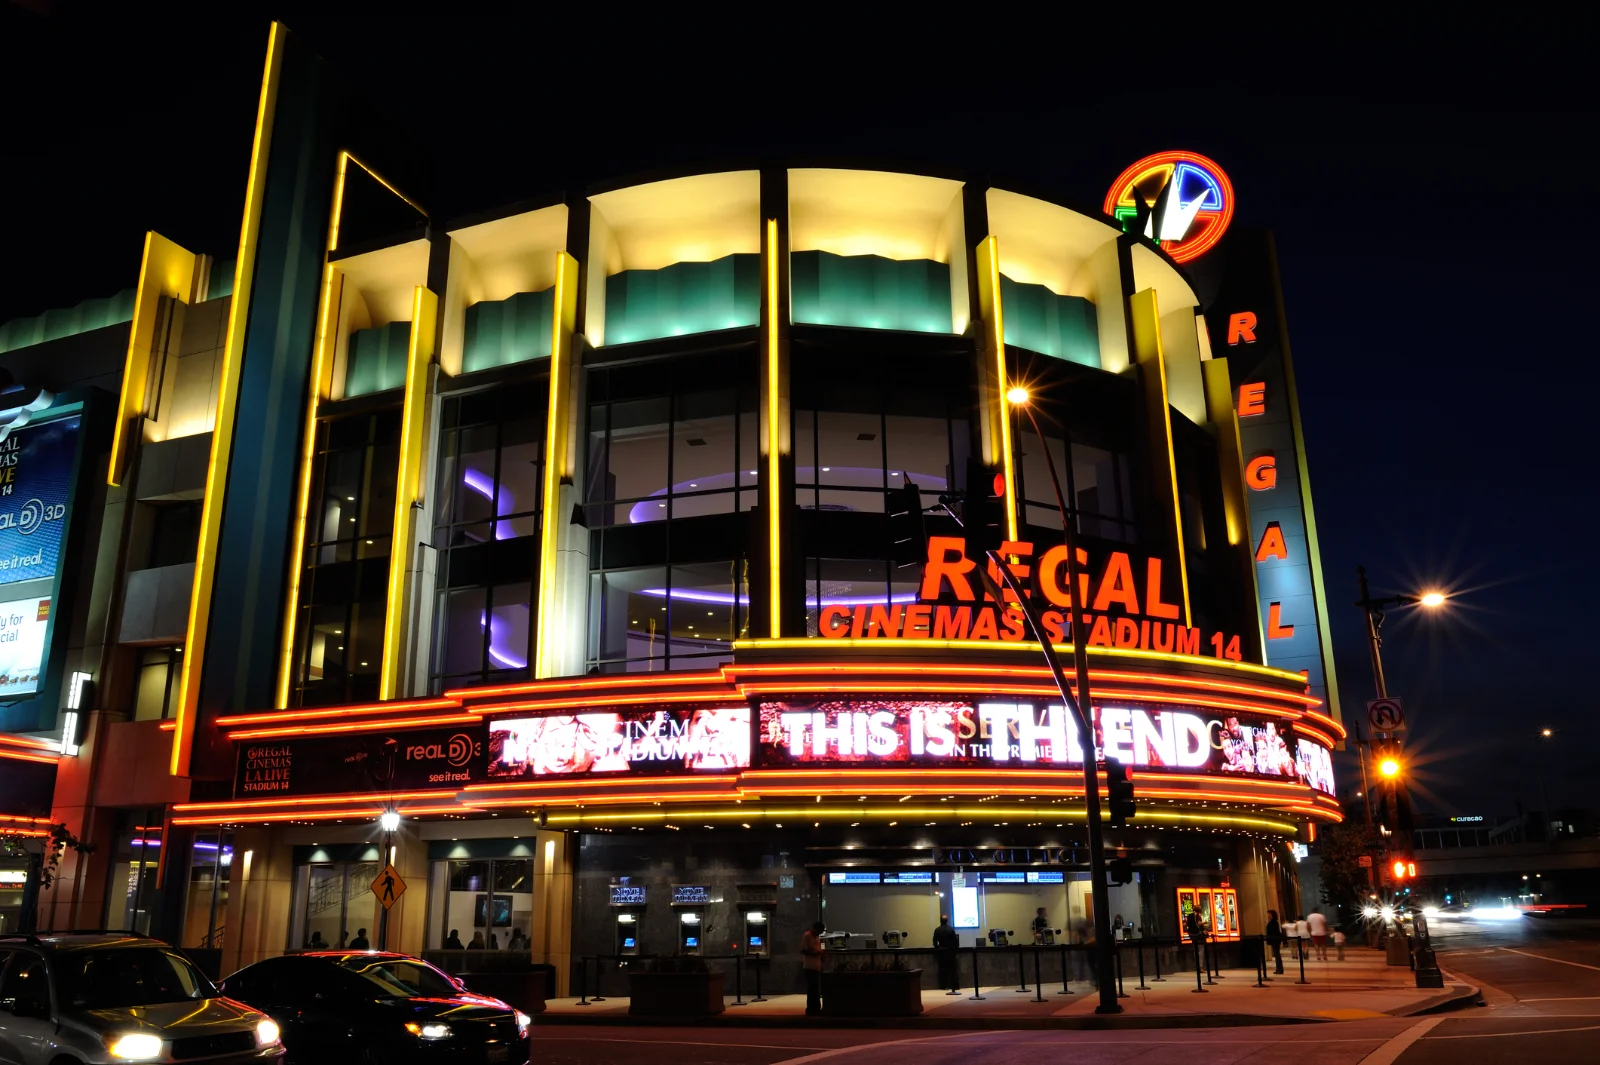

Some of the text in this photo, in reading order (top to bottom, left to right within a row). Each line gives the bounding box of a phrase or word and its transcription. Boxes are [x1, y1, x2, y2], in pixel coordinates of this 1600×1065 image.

[1227, 311, 1294, 640] REGAL
[2, 484, 12, 496] 14
[44, 504, 66, 521] 3D
[11, 554, 19, 568] it
[920, 536, 1180, 620] REGAL
[10, 613, 24, 626] for
[819, 603, 1026, 641] CINEMAS
[1211, 631, 1241, 661] 14
[781, 711, 898, 756] THIS
[910, 711, 957, 756] IS
[1101, 708, 1211, 767] END
[257, 746, 292, 758] REGAL
[246, 757, 291, 770] CINEMAS
[264, 768, 290, 781] LIVE
[428, 774, 444, 782] see
[445, 771, 451, 781] it
[244, 781, 289, 792] STADIUM 14
